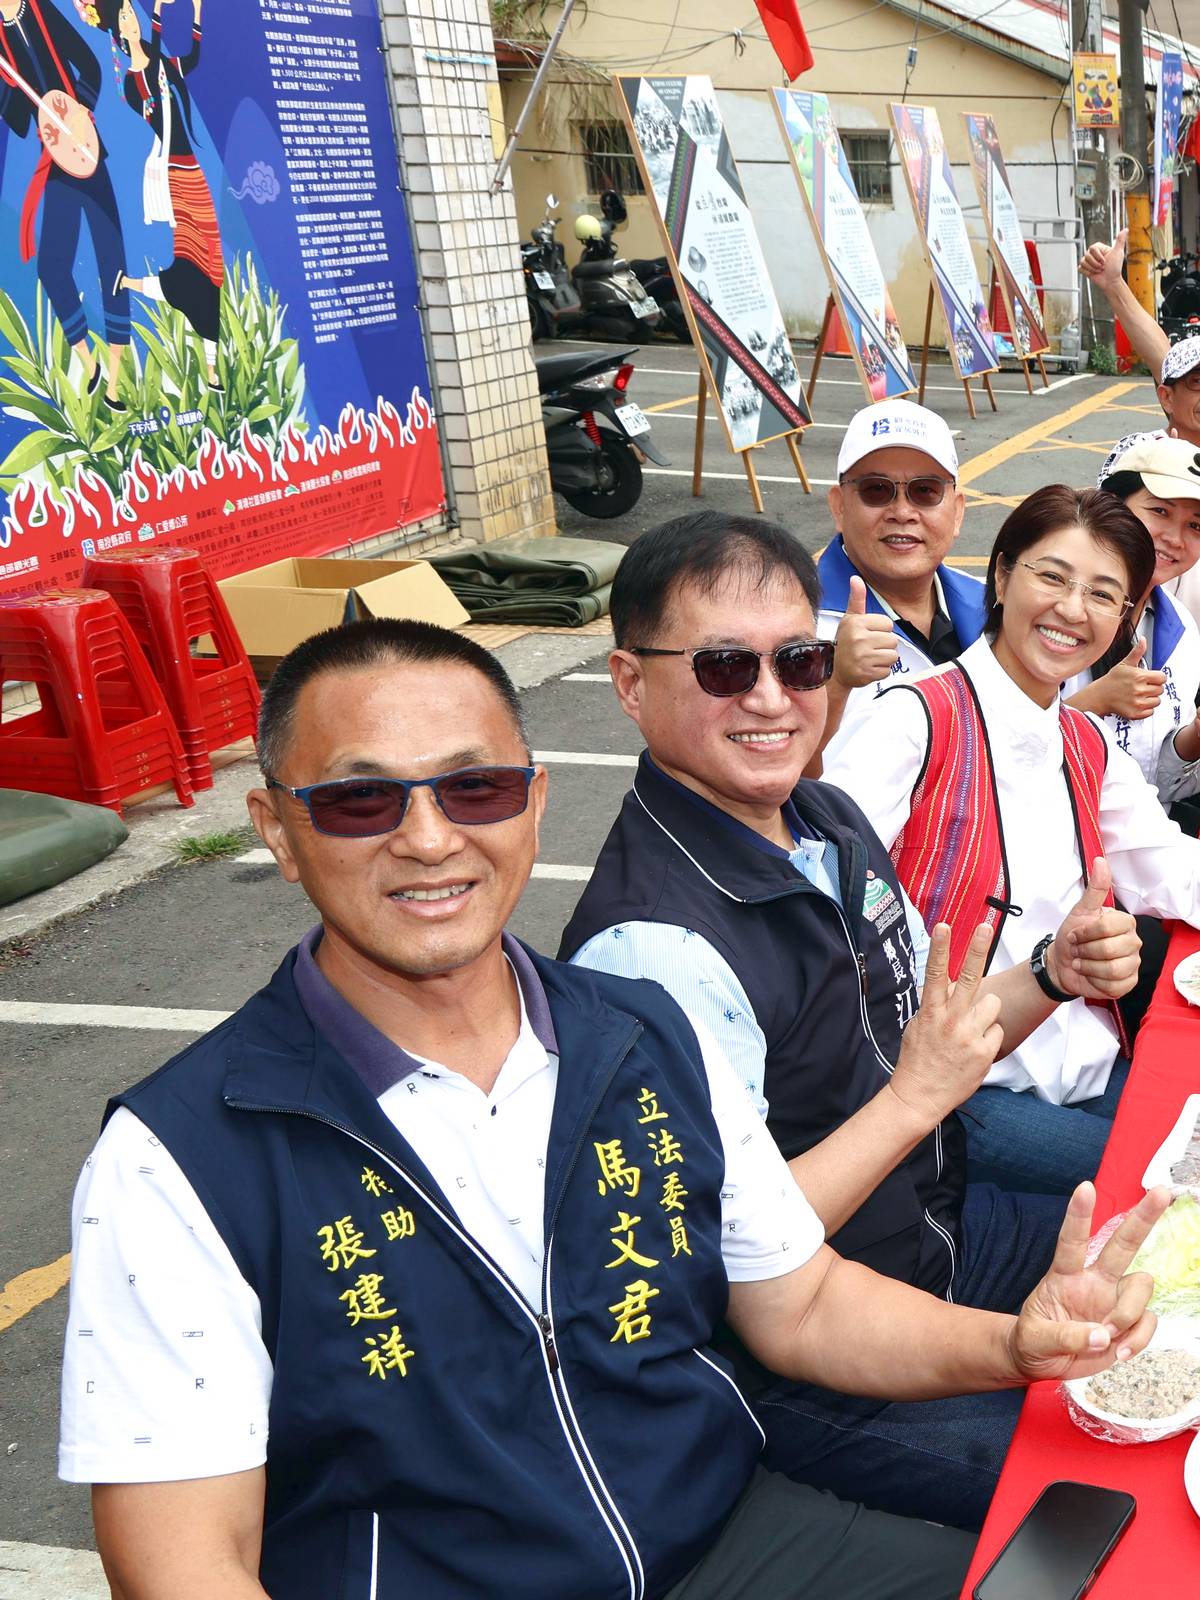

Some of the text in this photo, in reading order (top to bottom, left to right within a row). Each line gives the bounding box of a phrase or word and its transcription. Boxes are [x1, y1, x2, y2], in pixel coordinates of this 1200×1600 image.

[361, 1166, 416, 1242] 特助
[593, 1139, 660, 1344] 馬文君
[636, 1087, 692, 1258] 立法委員
[317, 1215, 415, 1380] 張建祥
[195, 1378, 204, 1390] R
